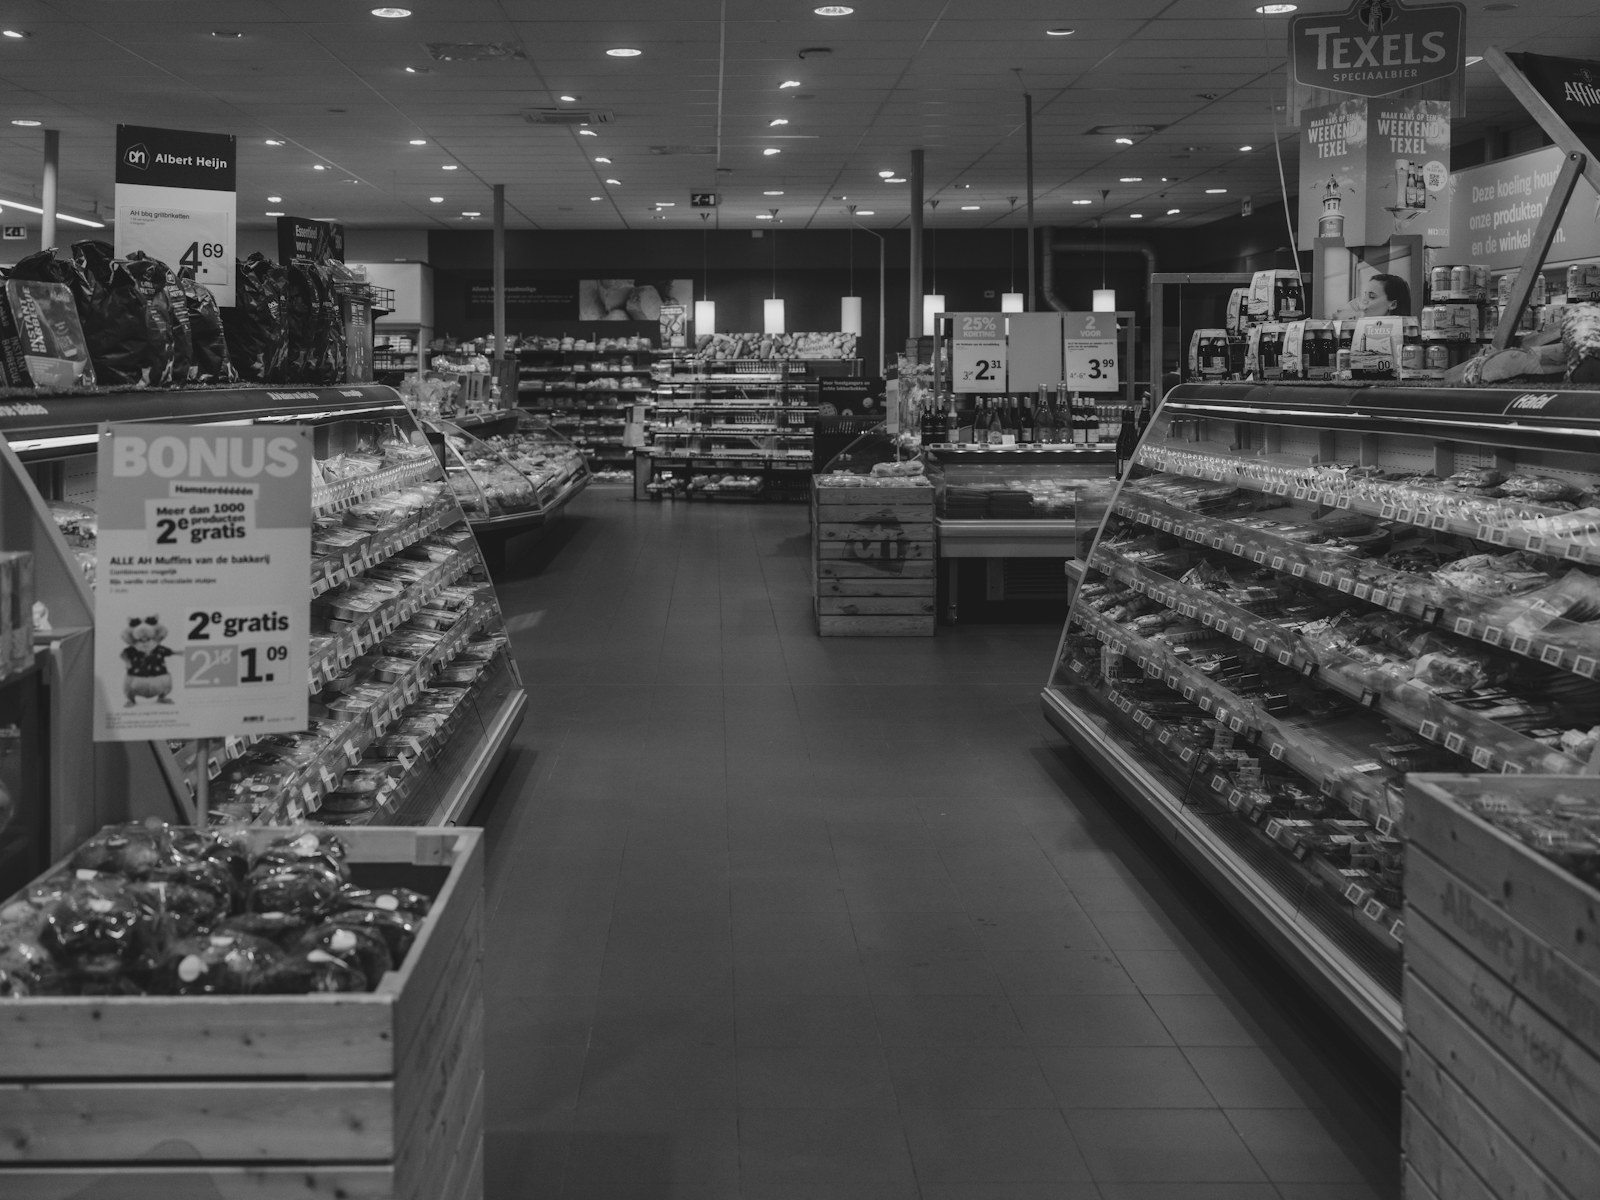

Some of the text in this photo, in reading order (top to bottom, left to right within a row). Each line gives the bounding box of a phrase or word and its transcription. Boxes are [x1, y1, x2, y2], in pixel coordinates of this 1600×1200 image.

[1305, 26, 1446, 70] TEXELS
[1333, 69, 1418, 82] SPECIAALBIER
[1308, 122, 1358, 144] WEEKEND
[1378, 119, 1438, 138] WEEKEND
[1318, 140, 1348, 158] TEXEL
[1390, 136, 1427, 154] TEXEL
[155, 154, 228, 170] Albert Heijn
[1472, 167, 1560, 204] Deze koeling houd
[1470, 212, 1492, 230] onze
[1494, 200, 1542, 230] produkten
[1472, 241, 1483, 256] en
[1486, 236, 1497, 254] de
[1499, 228, 1530, 252] winkel
[20, 299, 40, 352] INSTANT
[22, 286, 47, 353] BARBECUE
[962, 316, 996, 330] 25%
[1085, 316, 1096, 330] 2
[975, 360, 1002, 380] 2.31
[1088, 359, 1114, 379] 3.99
[113, 436, 299, 478] BONUS
[156, 503, 244, 516] Meer dan 1000
[191, 514, 245, 525] producten
[190, 523, 246, 543] gratis
[110, 557, 134, 566] ALLE
[138, 556, 152, 565] AH
[156, 555, 192, 565] Muffins
[216, 556, 228, 564] de
[231, 555, 270, 565] bakkerij
[224, 611, 289, 637] gratis
[240, 646, 287, 683] 1.09
